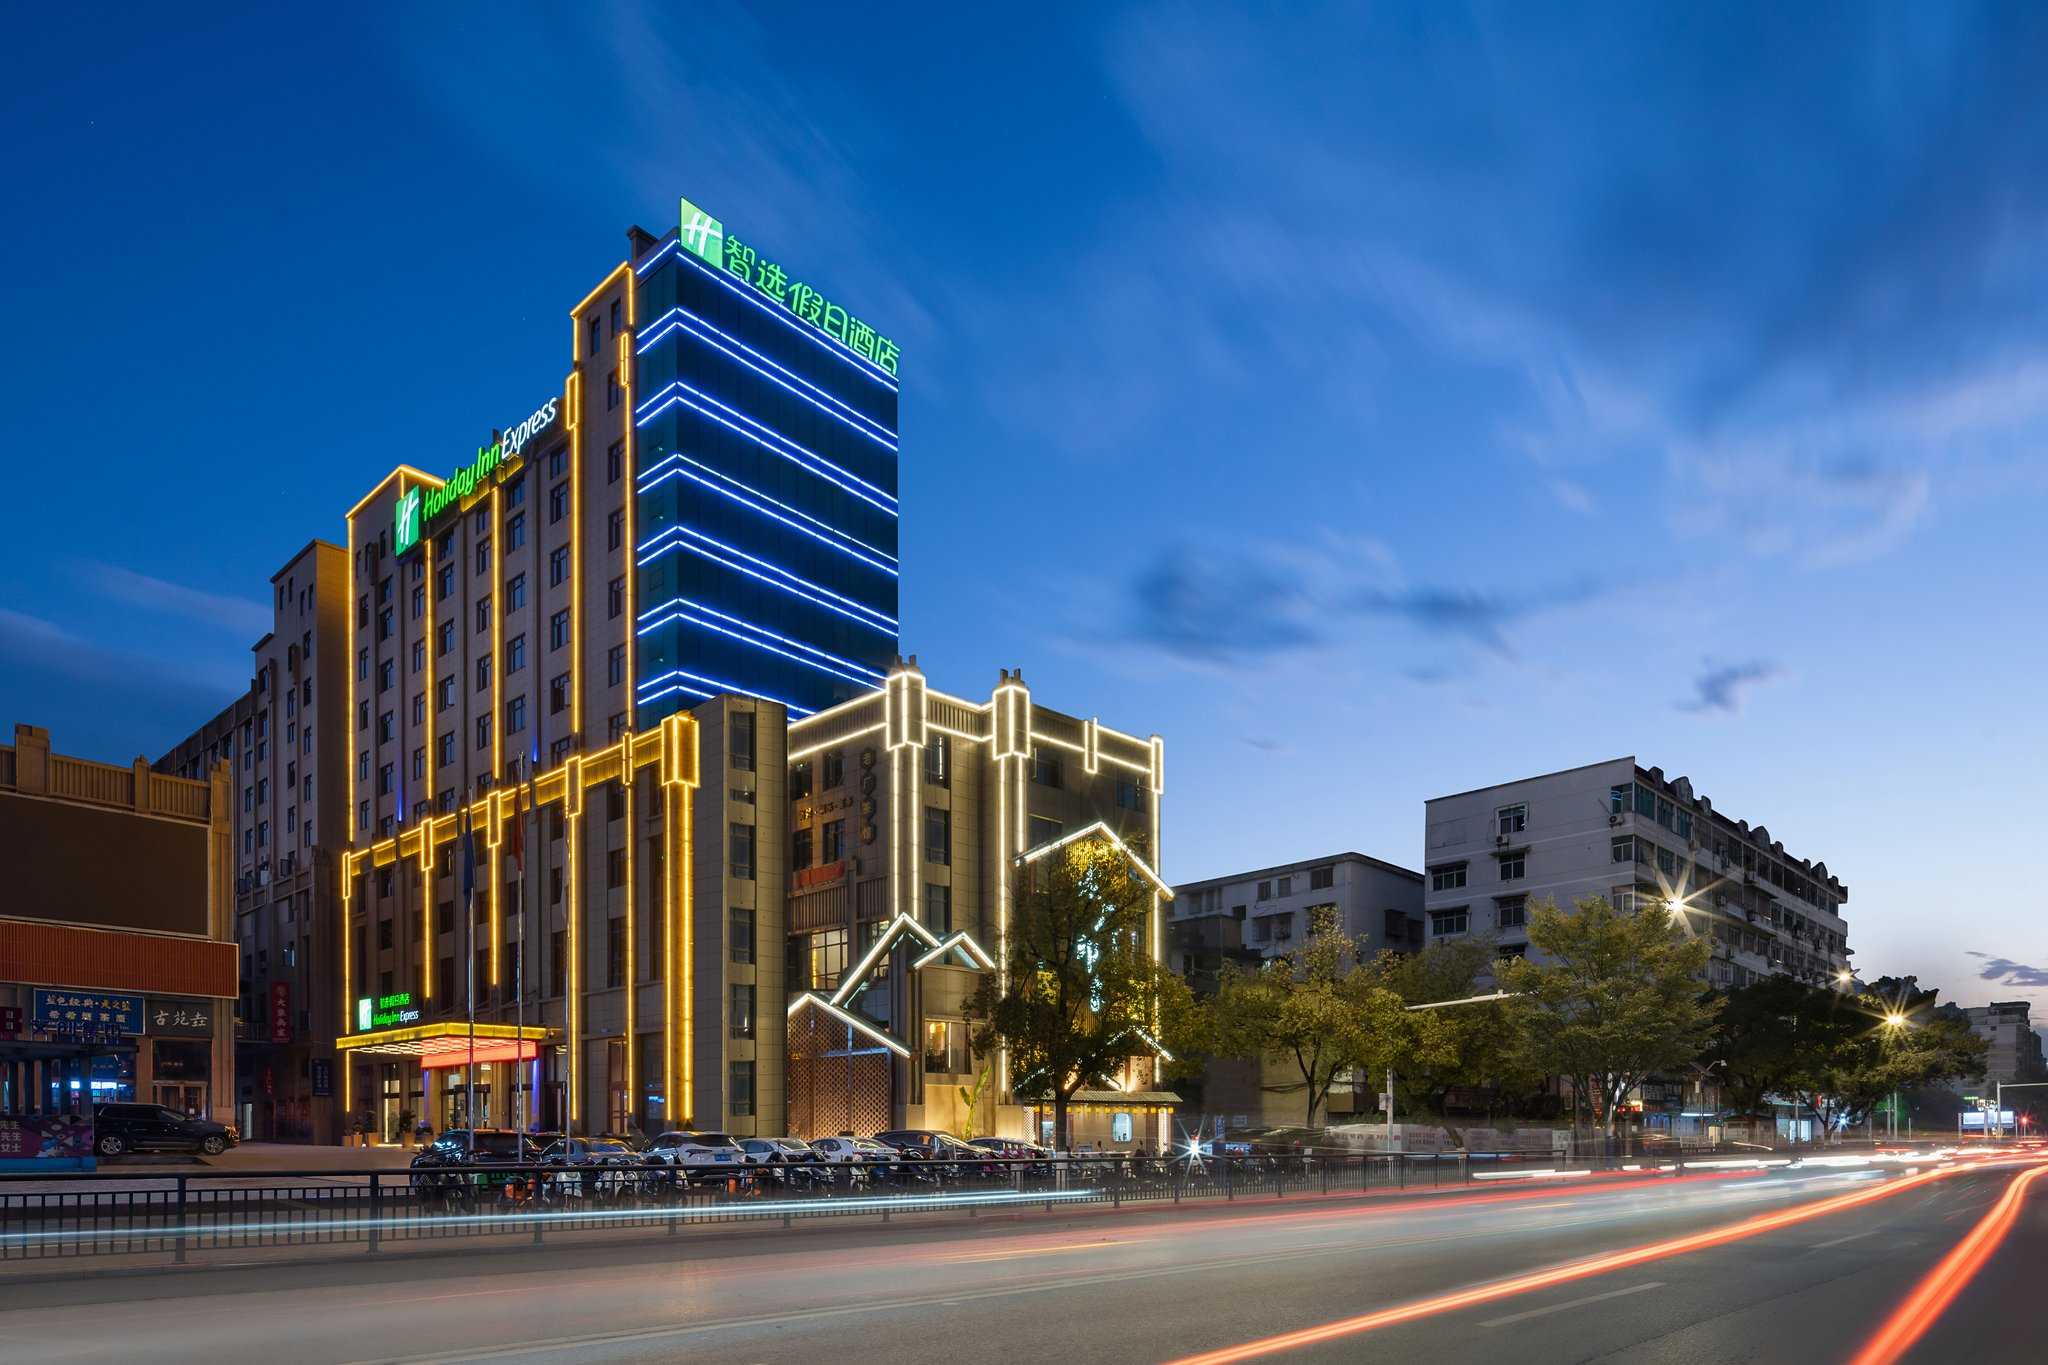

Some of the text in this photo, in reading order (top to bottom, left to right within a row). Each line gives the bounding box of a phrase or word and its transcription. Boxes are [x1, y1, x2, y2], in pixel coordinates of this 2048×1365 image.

[725, 235, 900, 375] 智选假日酒店
[423, 397, 557, 521] Holiday Inn Express
[400, 1010, 419, 1024] Express
